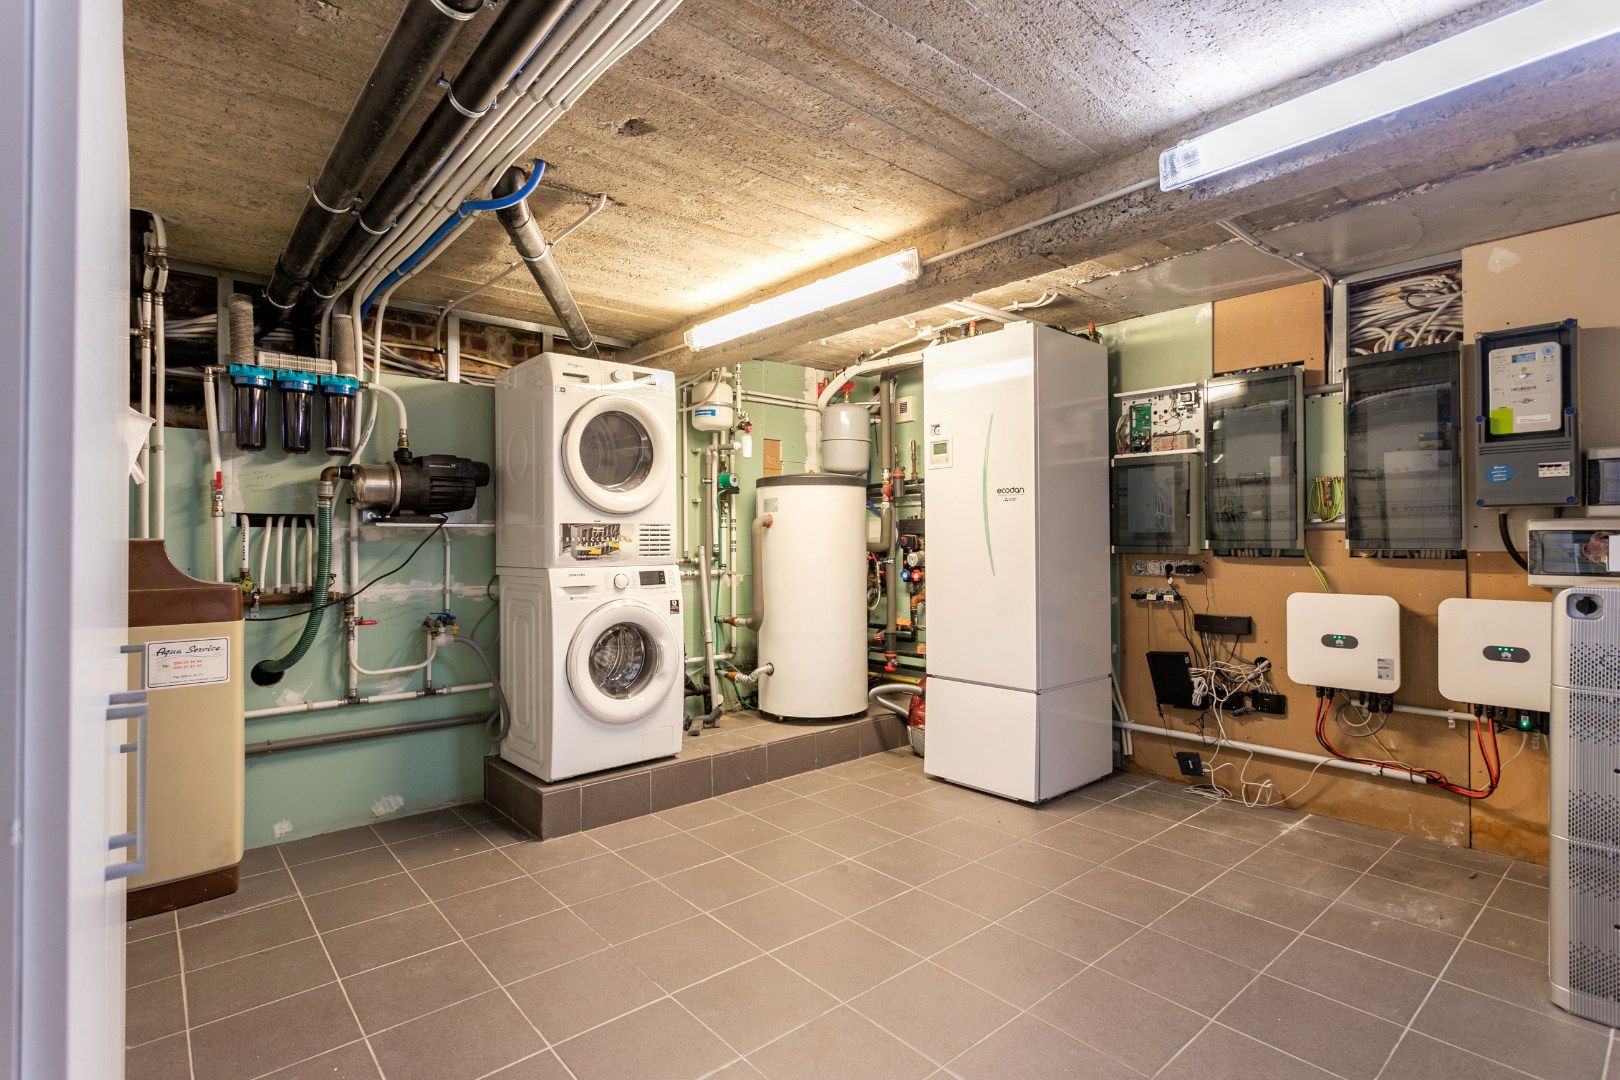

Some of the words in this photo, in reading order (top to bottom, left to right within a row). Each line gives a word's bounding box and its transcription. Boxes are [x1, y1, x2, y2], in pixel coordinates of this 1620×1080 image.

[997, 486, 1025, 494] ecodan
[156, 647, 182, 657] Aqua
[186, 644, 221, 654] Service
